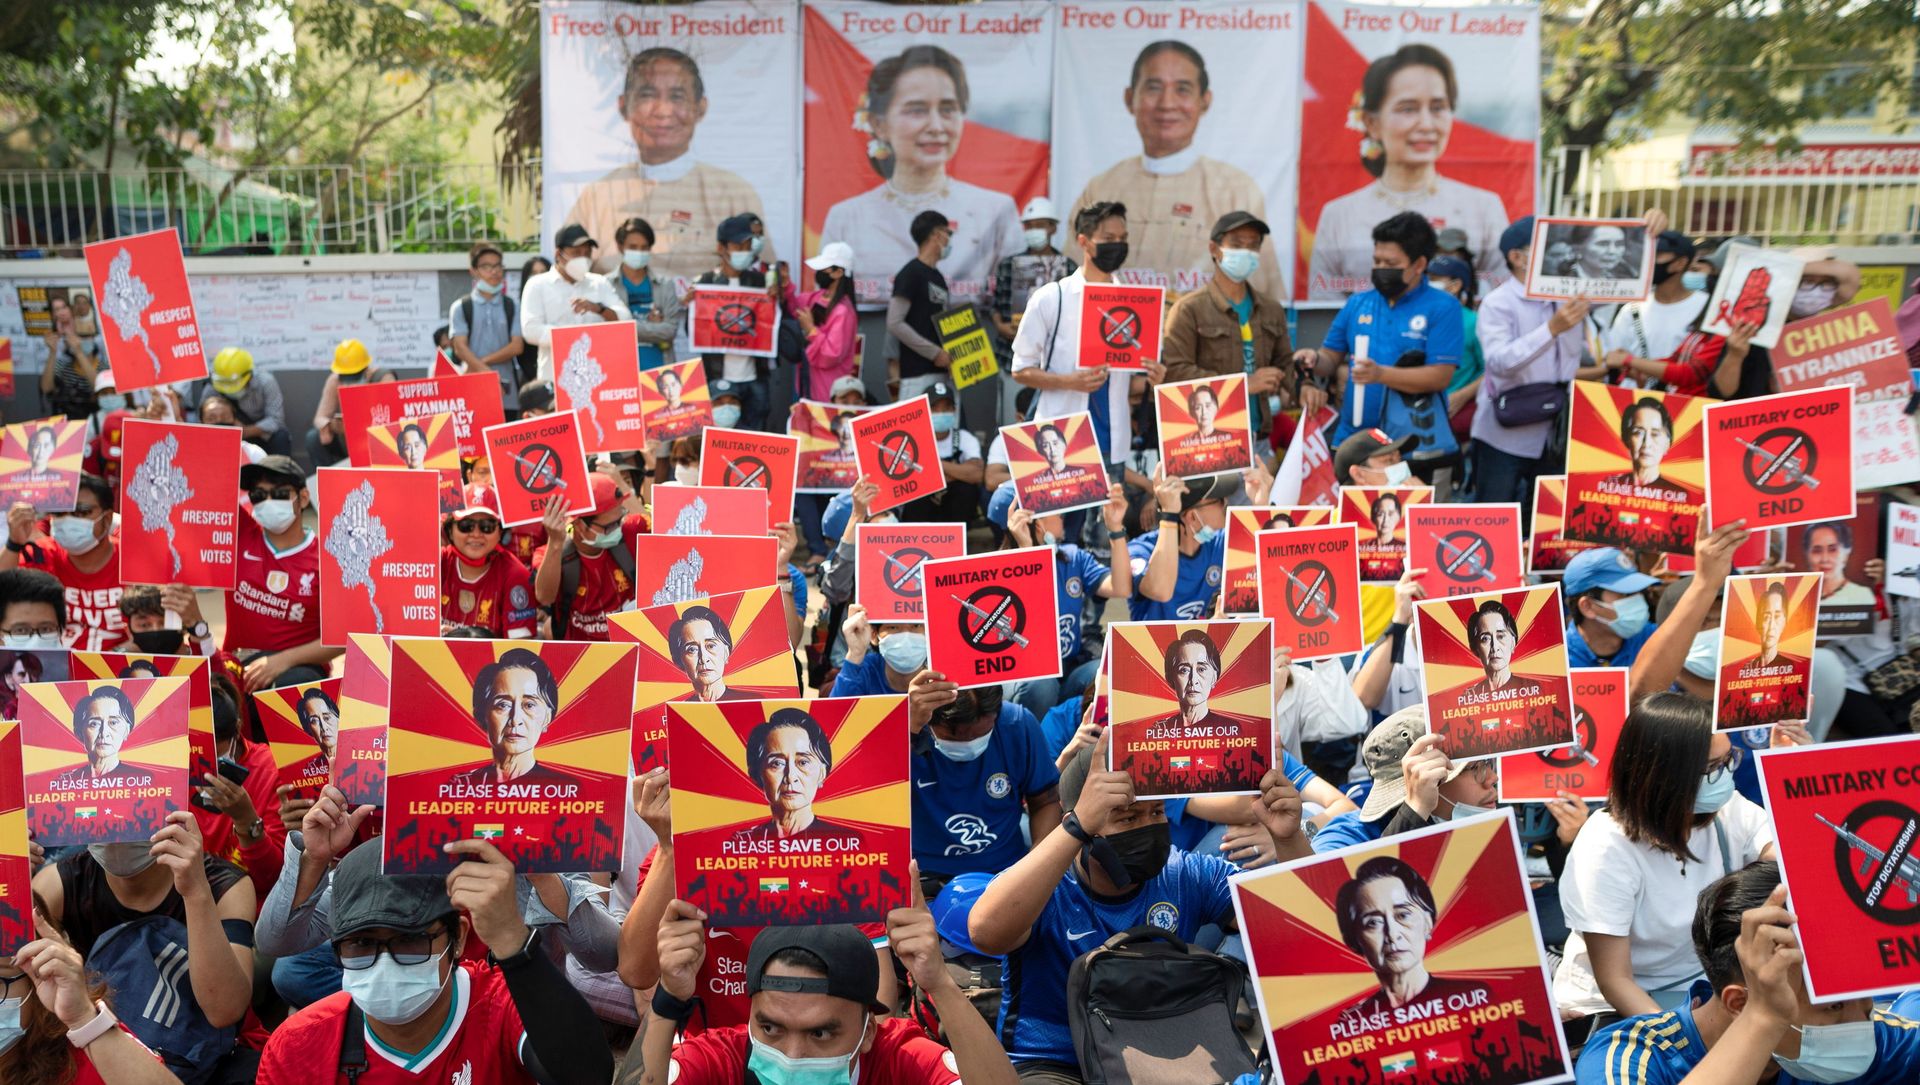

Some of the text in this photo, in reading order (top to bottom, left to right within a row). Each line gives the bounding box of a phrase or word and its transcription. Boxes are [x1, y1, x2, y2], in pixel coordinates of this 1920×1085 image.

[551, 14, 785, 36] Free Our President
[843, 12, 1044, 34] Free Our Leader
[1062, 6, 1293, 31] Free Our President
[1343, 9, 1527, 36] Free Our Leader
[1123, 270, 1170, 288] Win
[1089, 294, 1156, 304] MILITARY COUP
[149, 307, 193, 327] #RESPECT
[177, 325, 196, 338] OUR
[1784, 311, 1880, 357] CHINA
[172, 342, 200, 359] VOTES
[1105, 352, 1131, 363] END
[1779, 336, 1901, 385] TYRANNIZE
[397, 382, 439, 399] SUPPORT
[403, 398, 466, 416] MYANMAR
[860, 410, 923, 438] MILITARY COUP
[1719, 402, 1840, 431] MILITARY COUP
[495, 424, 569, 447] MILITARY COUP
[712, 439, 789, 455] MILITARY COUP
[893, 480, 918, 498] END
[1597, 481, 1687, 502] PLEASE SAVE OUR
[530, 496, 558, 512] EN
[1579, 490, 1621, 506] LEADER
[1626, 497, 1675, 511] FUTURE
[1758, 498, 1804, 518] END
[182, 510, 234, 526] #RESPECT
[1417, 516, 1510, 526] MILITARY COUP
[212, 530, 233, 545] OUR
[866, 535, 955, 544] MILITARY COUP
[200, 549, 232, 564] VOTES
[1267, 540, 1349, 558] MILITARY COUP
[382, 563, 435, 578] #RESPECT
[935, 563, 1043, 587] MILITARY COUP
[65, 587, 123, 608] EVER
[238, 581, 289, 609] Standard
[414, 584, 436, 599] OUR
[233, 591, 286, 621] Chartered
[402, 606, 435, 620] VOTES
[972, 595, 1011, 644] STOP DICTATORSHIP
[1298, 631, 1330, 648] END
[974, 656, 1016, 675] END
[1739, 664, 1793, 678] PLEASE SAVE OUR
[1576, 684, 1616, 696] COUP
[1727, 674, 1803, 690] LEADER FUTURE HOPE
[1458, 685, 1539, 706] PLEASE SAVE OUR
[1442, 695, 1557, 720] LEADER FUTURE HOPE
[1146, 725, 1239, 740] PLEASE SAVE OUR
[1127, 737, 1257, 752] LEADER FUTURE HOPE
[50, 775, 151, 791] PLEASE SAVE OUR
[1544, 773, 1585, 788] END
[1783, 768, 1888, 799] MILITARY
[29, 786, 172, 804] LEADER FUTURE HOPE
[439, 784, 578, 799] PLEASE SAVE OUR
[409, 801, 604, 815] LEADER FUTURE HOPE
[723, 837, 860, 854] PLEASE SAVE OUR
[696, 852, 888, 870] LEADER FUTURE HOPE
[1866, 819, 1917, 907] STOP DICTATORSHIP
[1329, 989, 1489, 1040] PLEASE SAVE OUR
[1302, 999, 1526, 1067] LEADER FUTURE HOPE
